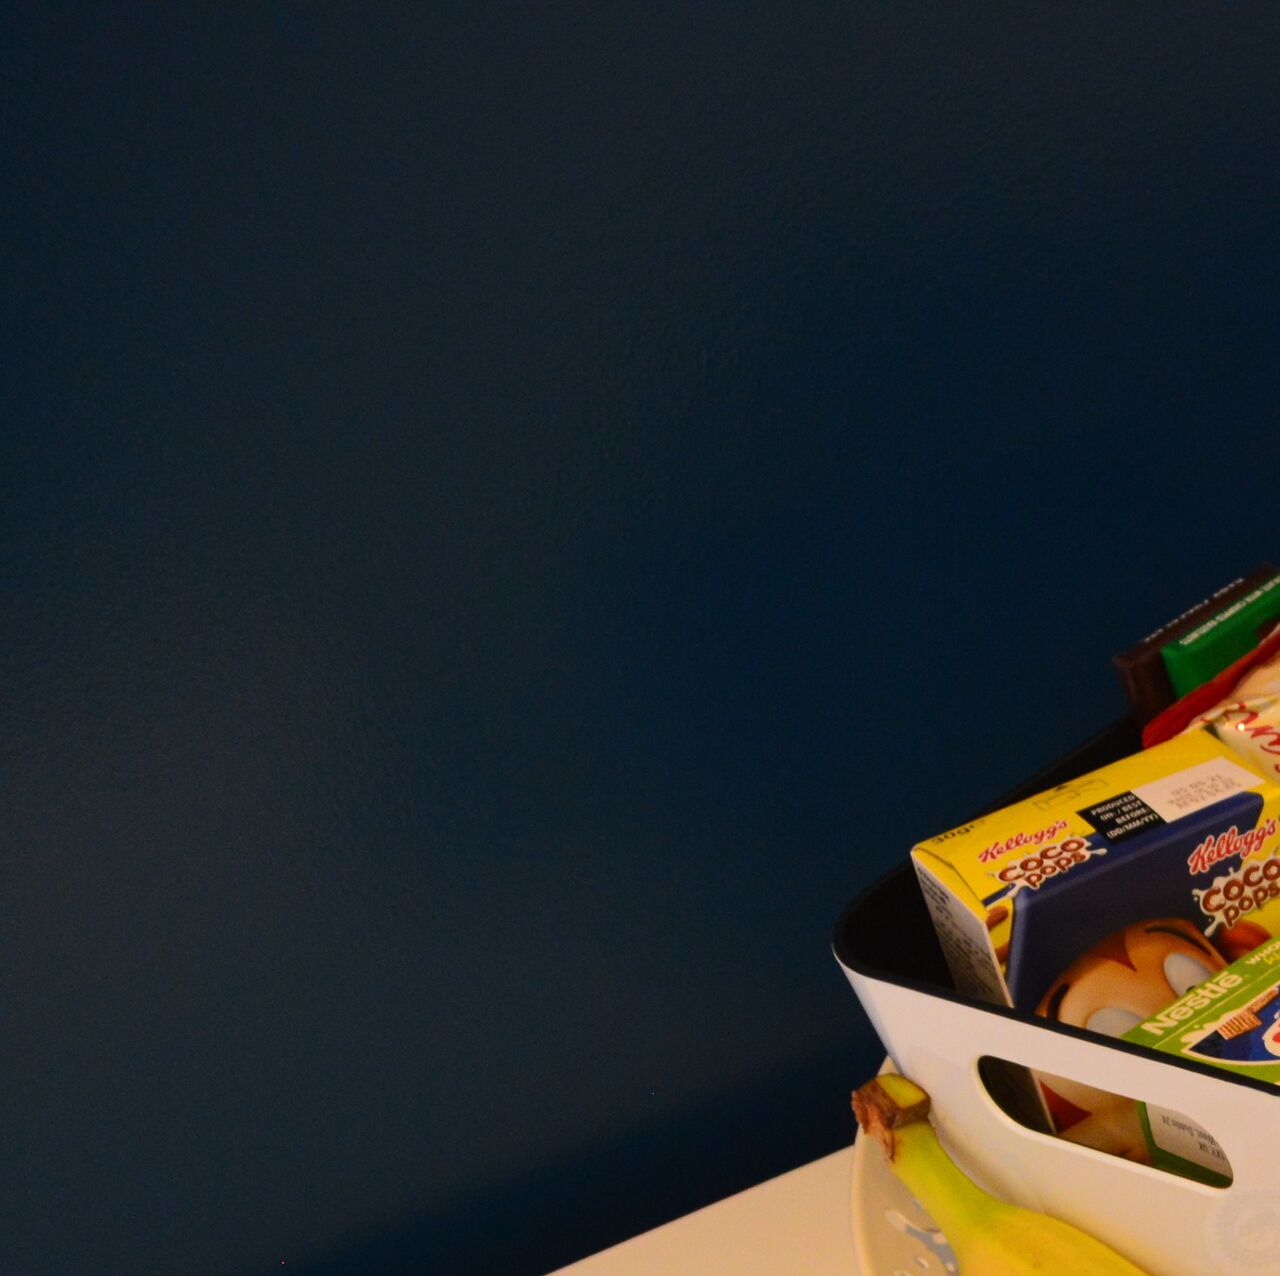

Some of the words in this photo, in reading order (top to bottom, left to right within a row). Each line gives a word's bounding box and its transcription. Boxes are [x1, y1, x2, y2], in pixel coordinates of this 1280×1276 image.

[1090, 794, 1136, 817] PRODUCED
[978, 820, 1069, 864] Kellogg's
[998, 838, 1086, 883] COCO
[1188, 818, 1277, 875] Kellogg's
[1023, 852, 1088, 889] pops
